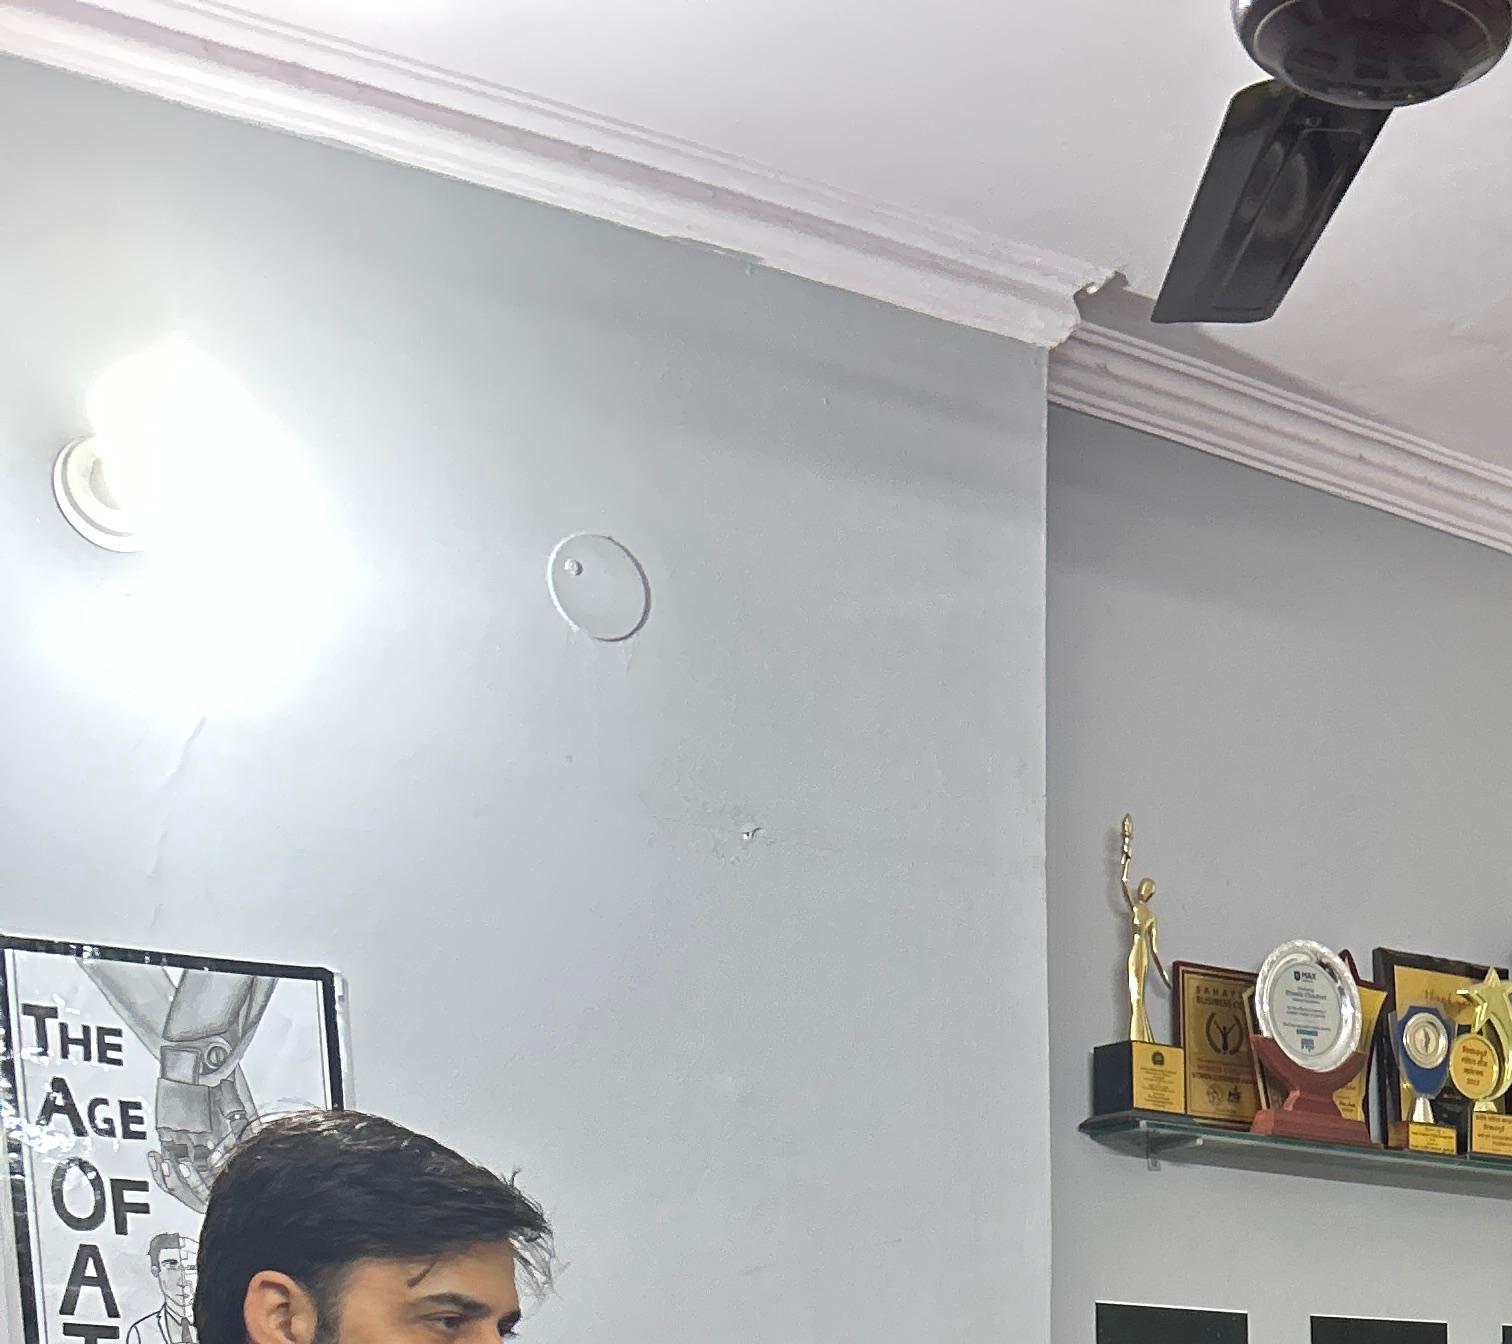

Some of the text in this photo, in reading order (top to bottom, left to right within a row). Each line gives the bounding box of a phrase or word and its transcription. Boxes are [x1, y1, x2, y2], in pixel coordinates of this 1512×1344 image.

[21, 1003, 123, 1066] THE
[36, 1077, 147, 1140] AGE
[50, 1158, 151, 1236] OF
